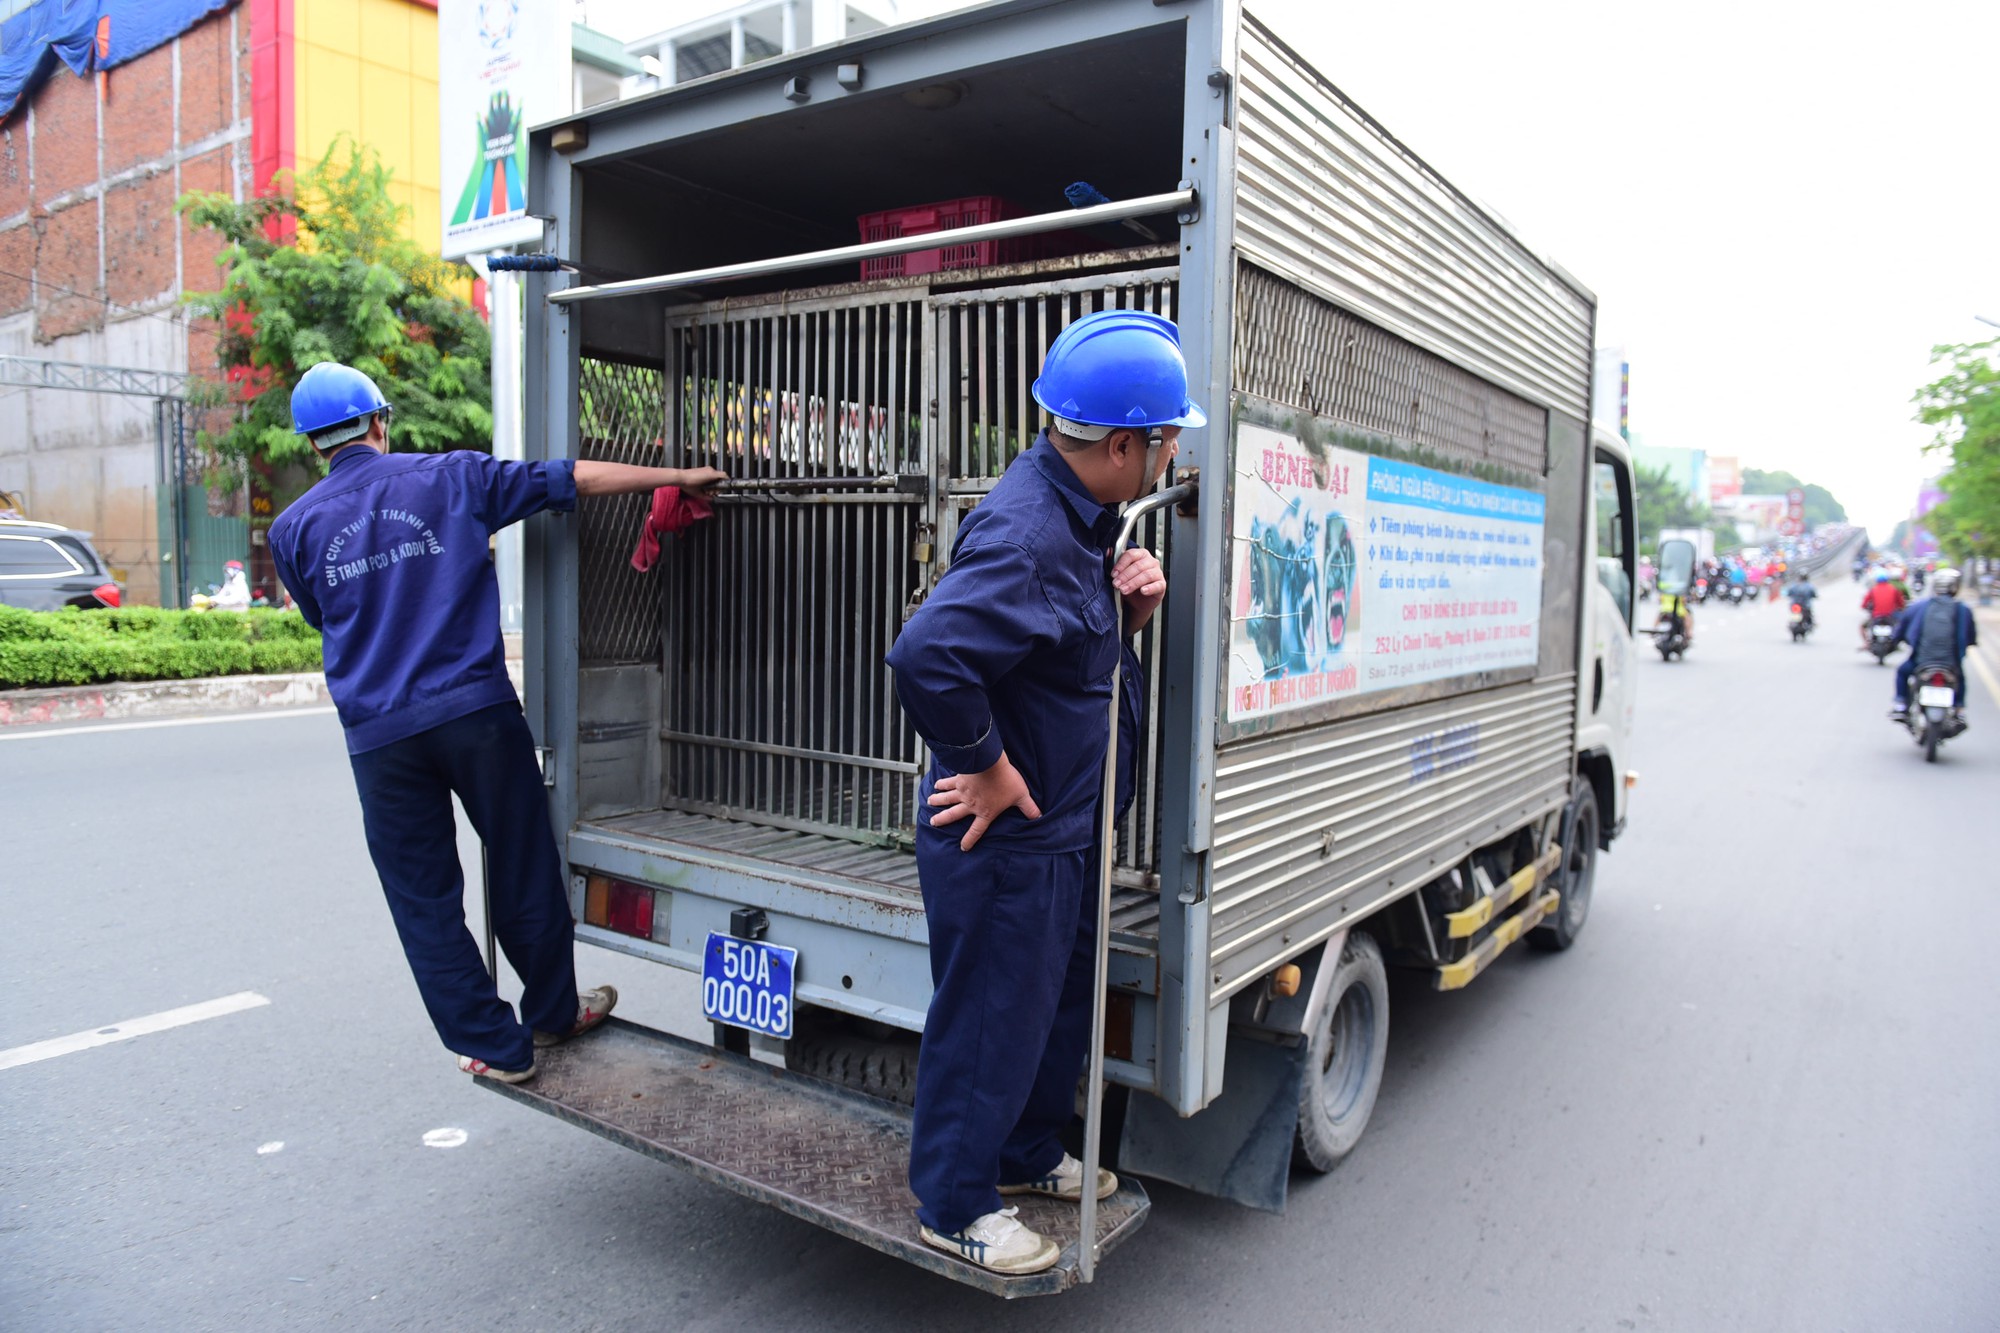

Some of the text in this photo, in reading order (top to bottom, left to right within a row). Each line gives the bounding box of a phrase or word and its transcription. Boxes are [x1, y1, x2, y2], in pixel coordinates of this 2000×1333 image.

[1262, 441, 1313, 492] BỆNH
[252, 496, 272, 513] 96
[369, 510, 376, 521] Y
[326, 536, 345, 561] CỤC
[422, 529, 446, 555] PHỐ
[325, 565, 338, 587] CHI
[337, 558, 369, 580] TRẠM
[369, 552, 389, 572] PCD
[390, 548, 399, 563] &
[1376, 636, 1390, 654] 252
[1369, 665, 1386, 680] Sau
[1388, 665, 1398, 676] 72
[1235, 682, 1266, 713] NGUY
[724, 941, 769, 987] 50A
[704, 977, 788, 1032] 000.03
